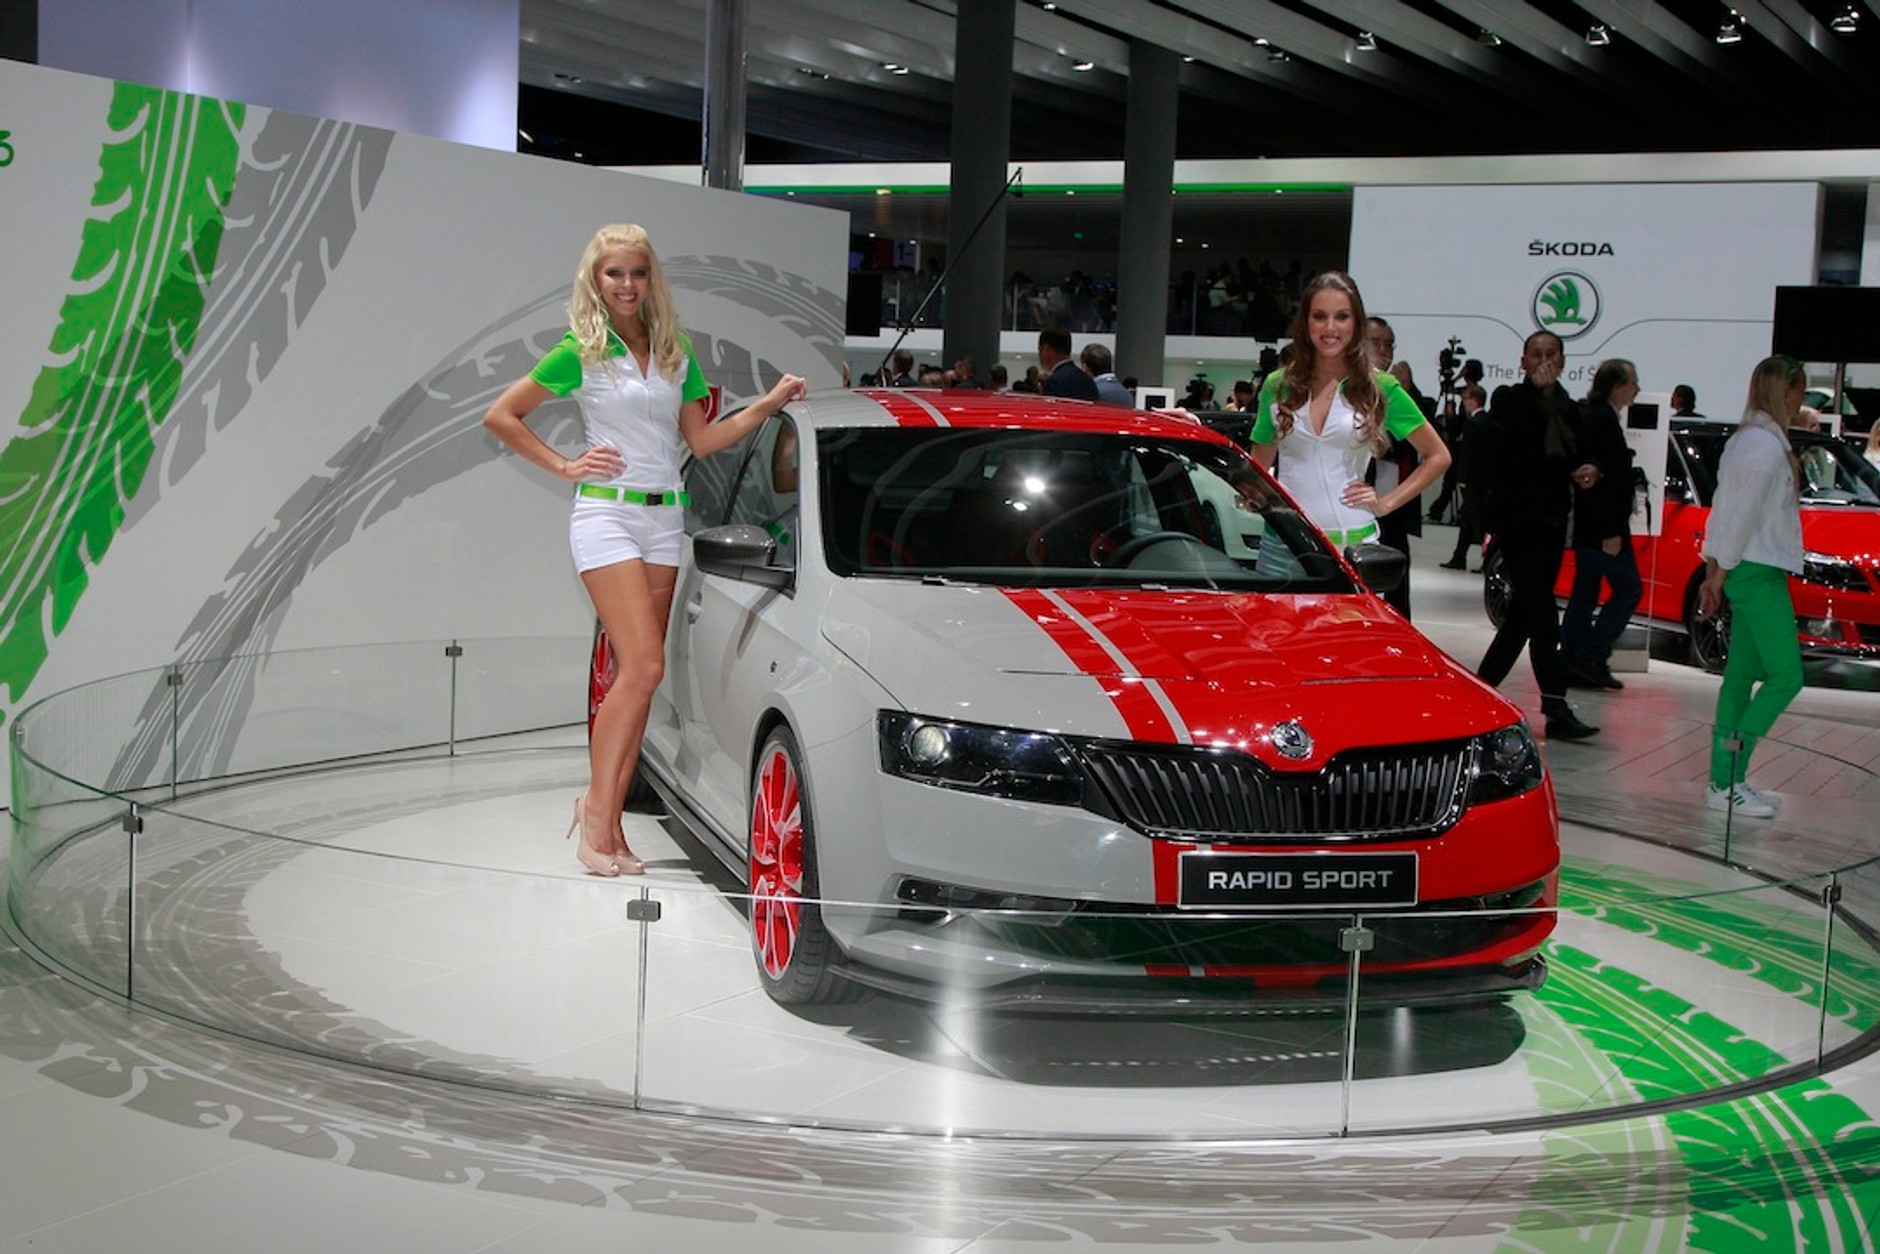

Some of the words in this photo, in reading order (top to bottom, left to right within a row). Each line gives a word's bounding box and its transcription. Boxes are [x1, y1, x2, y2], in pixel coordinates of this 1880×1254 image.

[1528, 239, 1614, 256] ŠKODA
[1487, 364, 1514, 379] The
[1568, 365, 1585, 381] of
[1208, 871, 1293, 890] RAPID
[1302, 870, 1394, 889] SPORT
